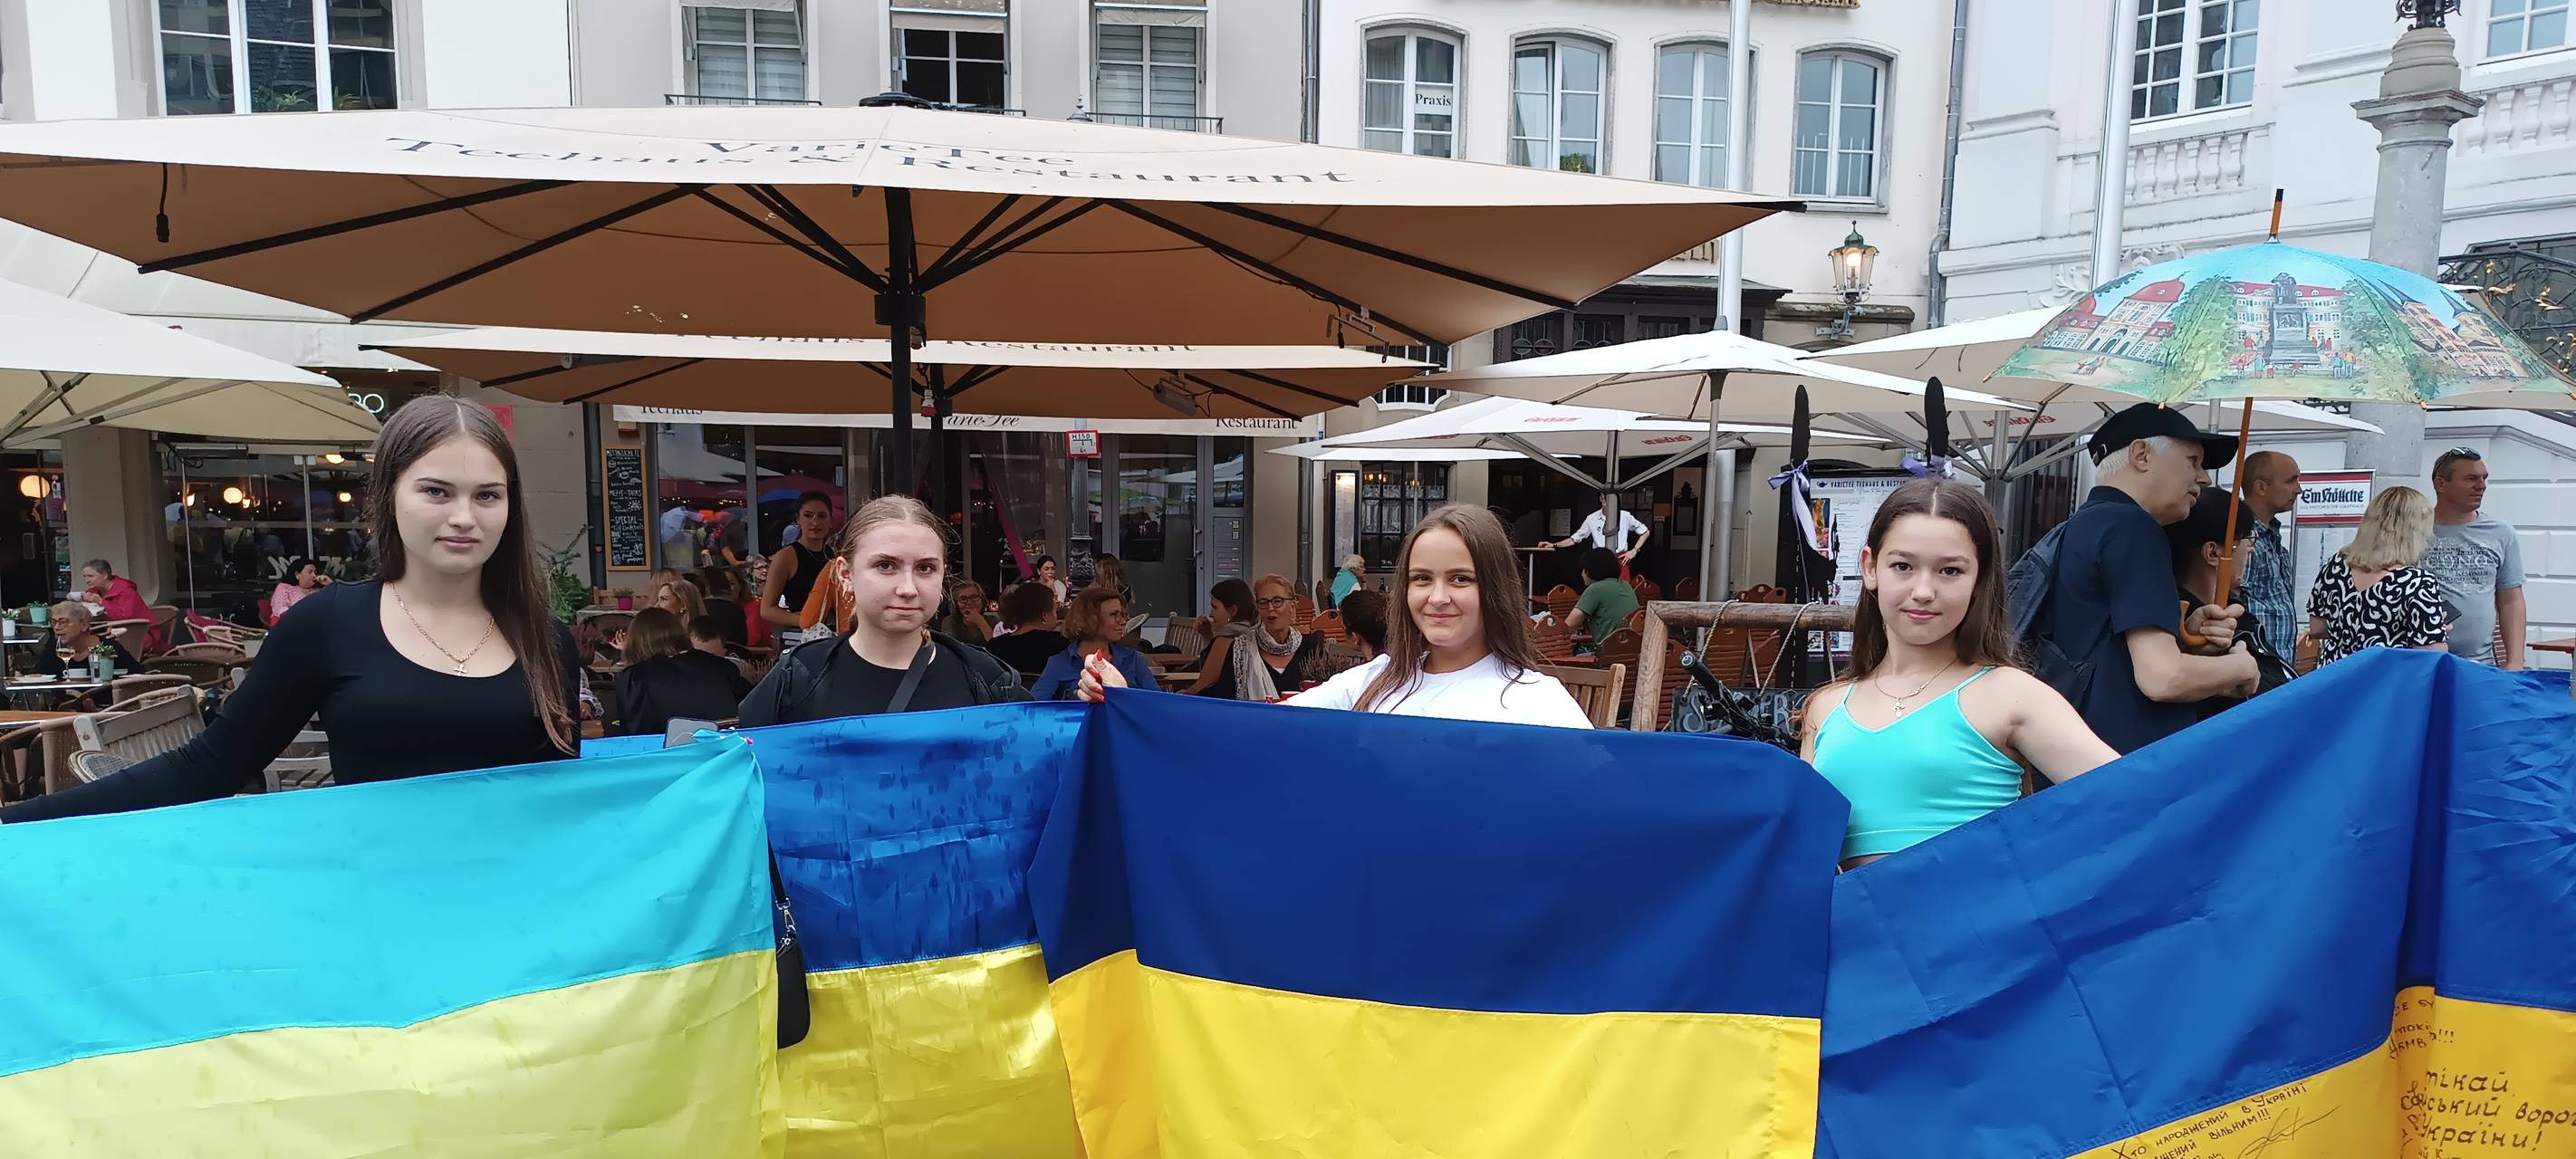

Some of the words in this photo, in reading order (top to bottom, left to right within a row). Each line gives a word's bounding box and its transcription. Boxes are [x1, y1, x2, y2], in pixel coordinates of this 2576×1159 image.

[1415, 93, 1451, 106] Praxis
[386, 138, 755, 164] Teehaus
[788, 154, 857, 165] &
[900, 156, 1356, 184] Restaurant
[705, 139, 1074, 166] VarieTee
[947, 415, 1020, 427] arieTee
